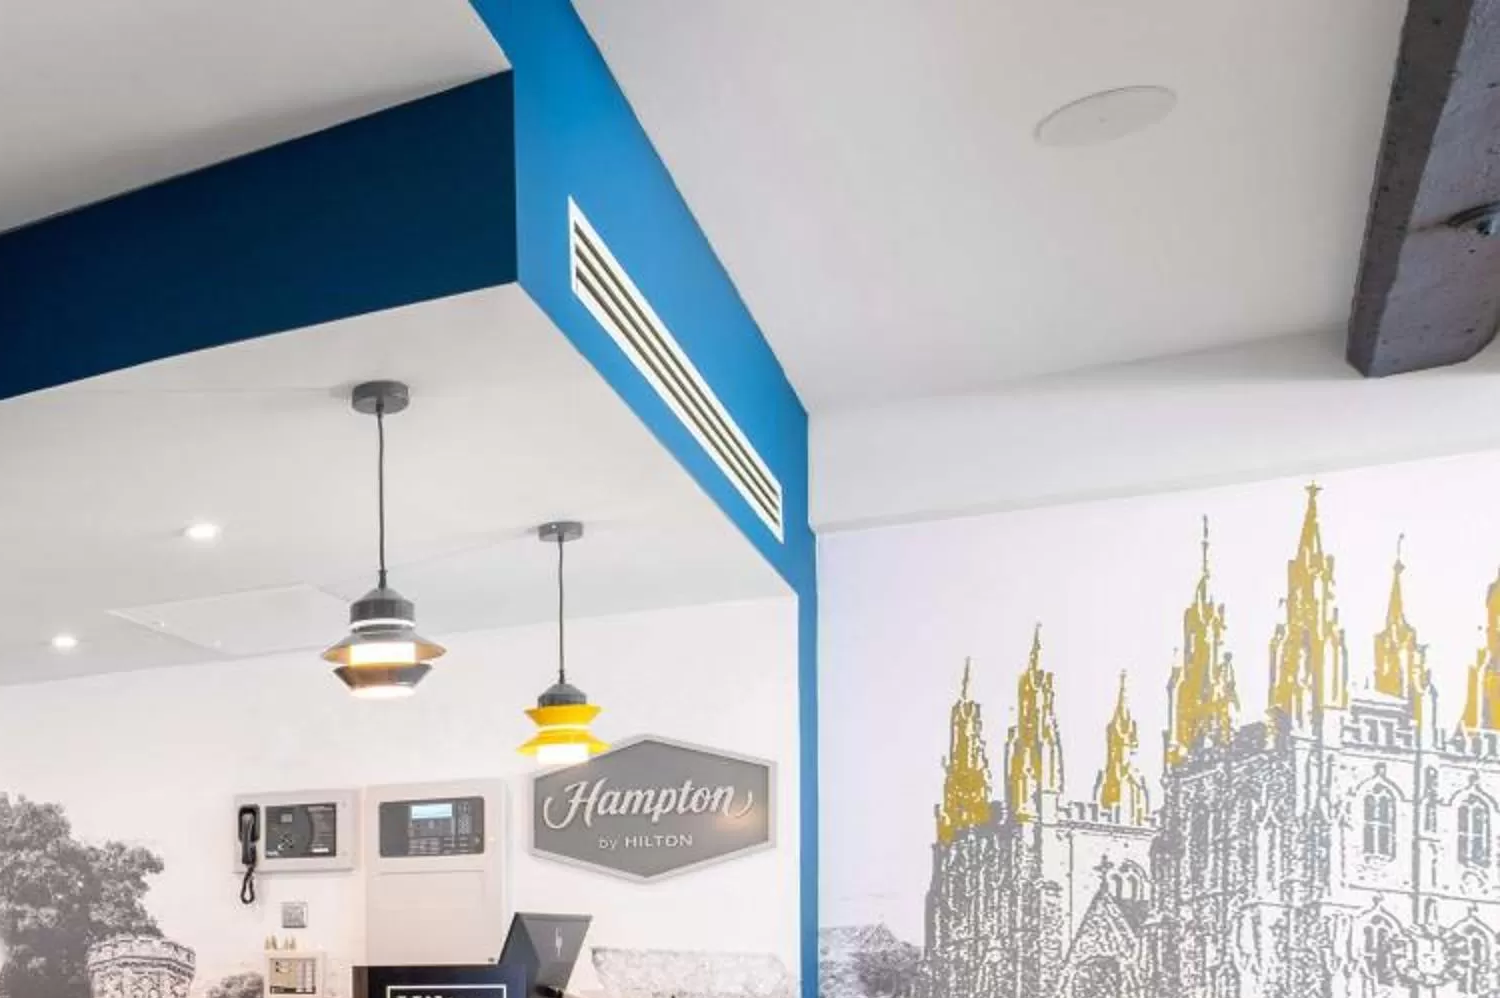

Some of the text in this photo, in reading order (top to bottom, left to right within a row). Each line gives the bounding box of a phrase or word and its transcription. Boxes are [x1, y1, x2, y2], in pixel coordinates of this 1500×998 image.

[543, 777, 755, 829] Hampton
[598, 834, 693, 850] by HILTON
